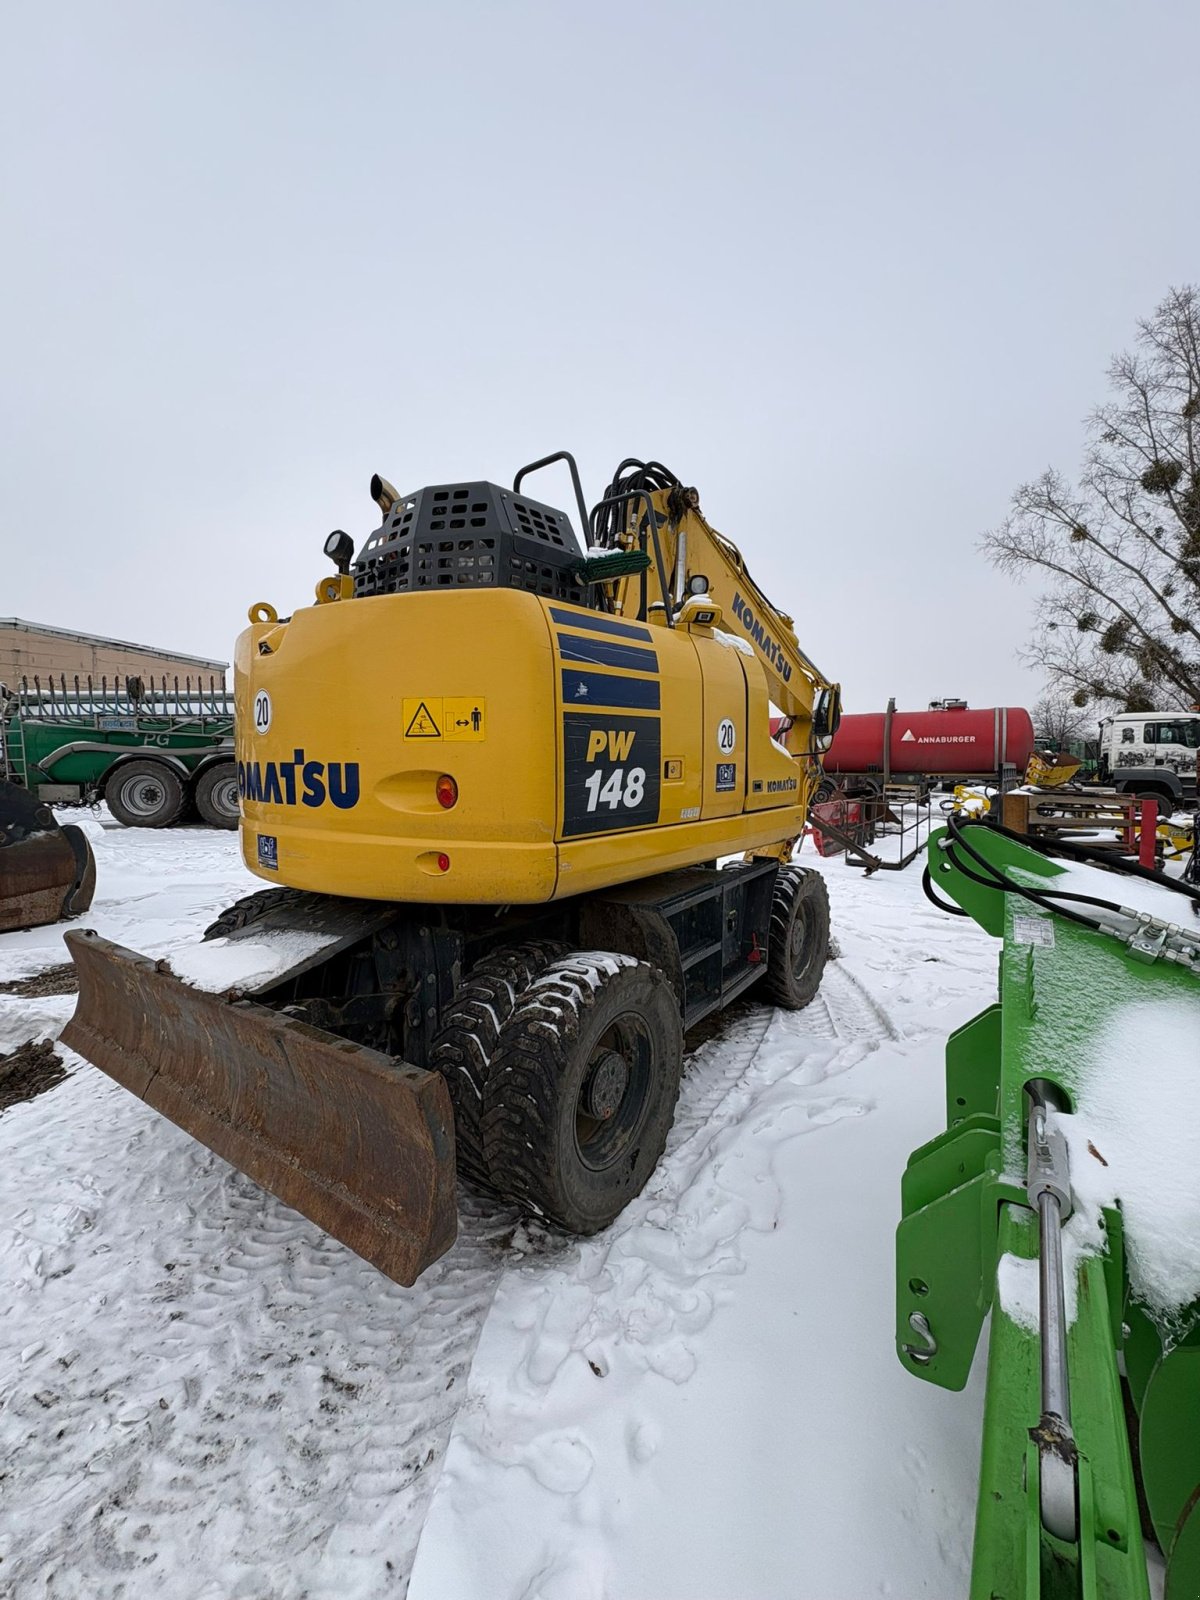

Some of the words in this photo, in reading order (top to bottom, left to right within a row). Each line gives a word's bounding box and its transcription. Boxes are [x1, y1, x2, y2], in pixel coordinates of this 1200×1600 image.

[732, 591, 792, 682] KOMATSU
[256, 696, 269, 726] 20
[586, 730, 636, 762] PW
[721, 724, 733, 748] 20
[917, 735, 976, 744] ANNABURGER
[238, 749, 360, 809] OMATSU
[585, 767, 646, 812] 148
[767, 776, 797, 793] KOMATSU
